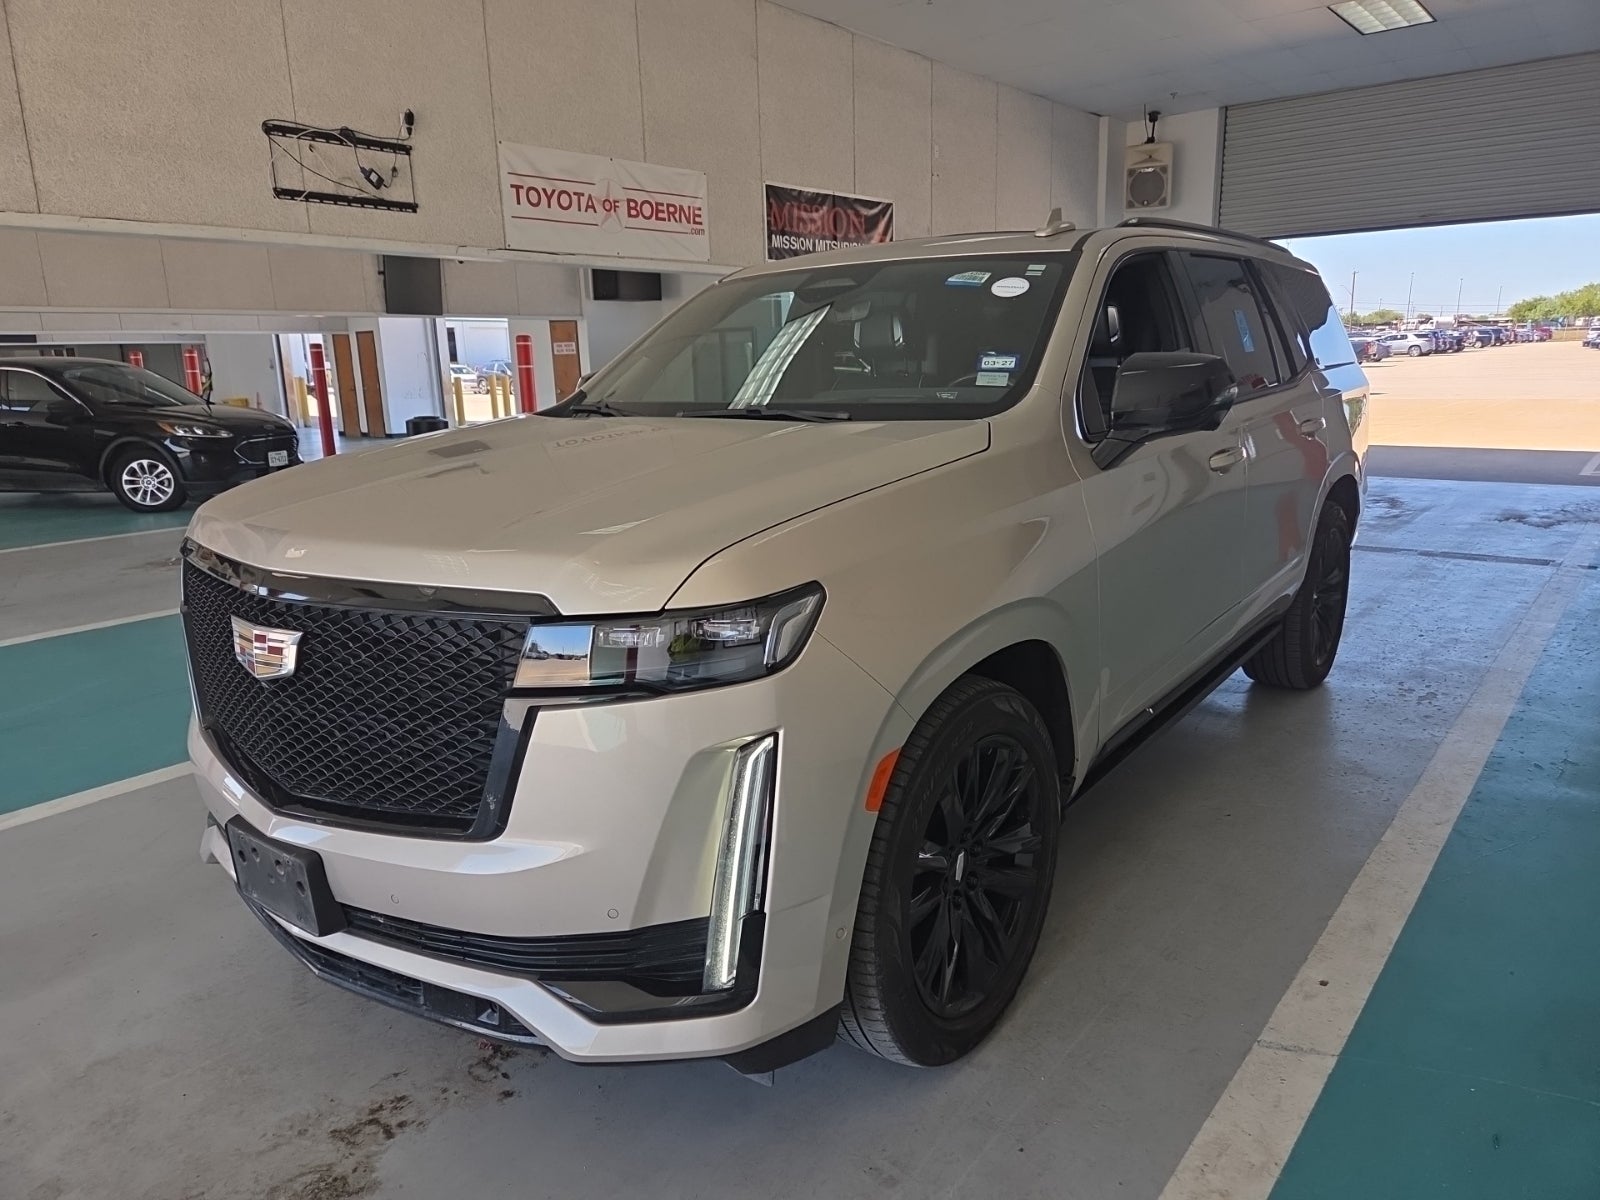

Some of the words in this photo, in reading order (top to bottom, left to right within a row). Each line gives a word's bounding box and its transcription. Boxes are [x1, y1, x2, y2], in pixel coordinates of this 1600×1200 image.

[510, 184, 597, 213] TOYOTA
[602, 198, 620, 213] OF
[626, 198, 703, 226] BOERNE
[769, 199, 867, 240] MISSION
[688, 227, 705, 236] .com
[771, 234, 813, 251] MISSION
